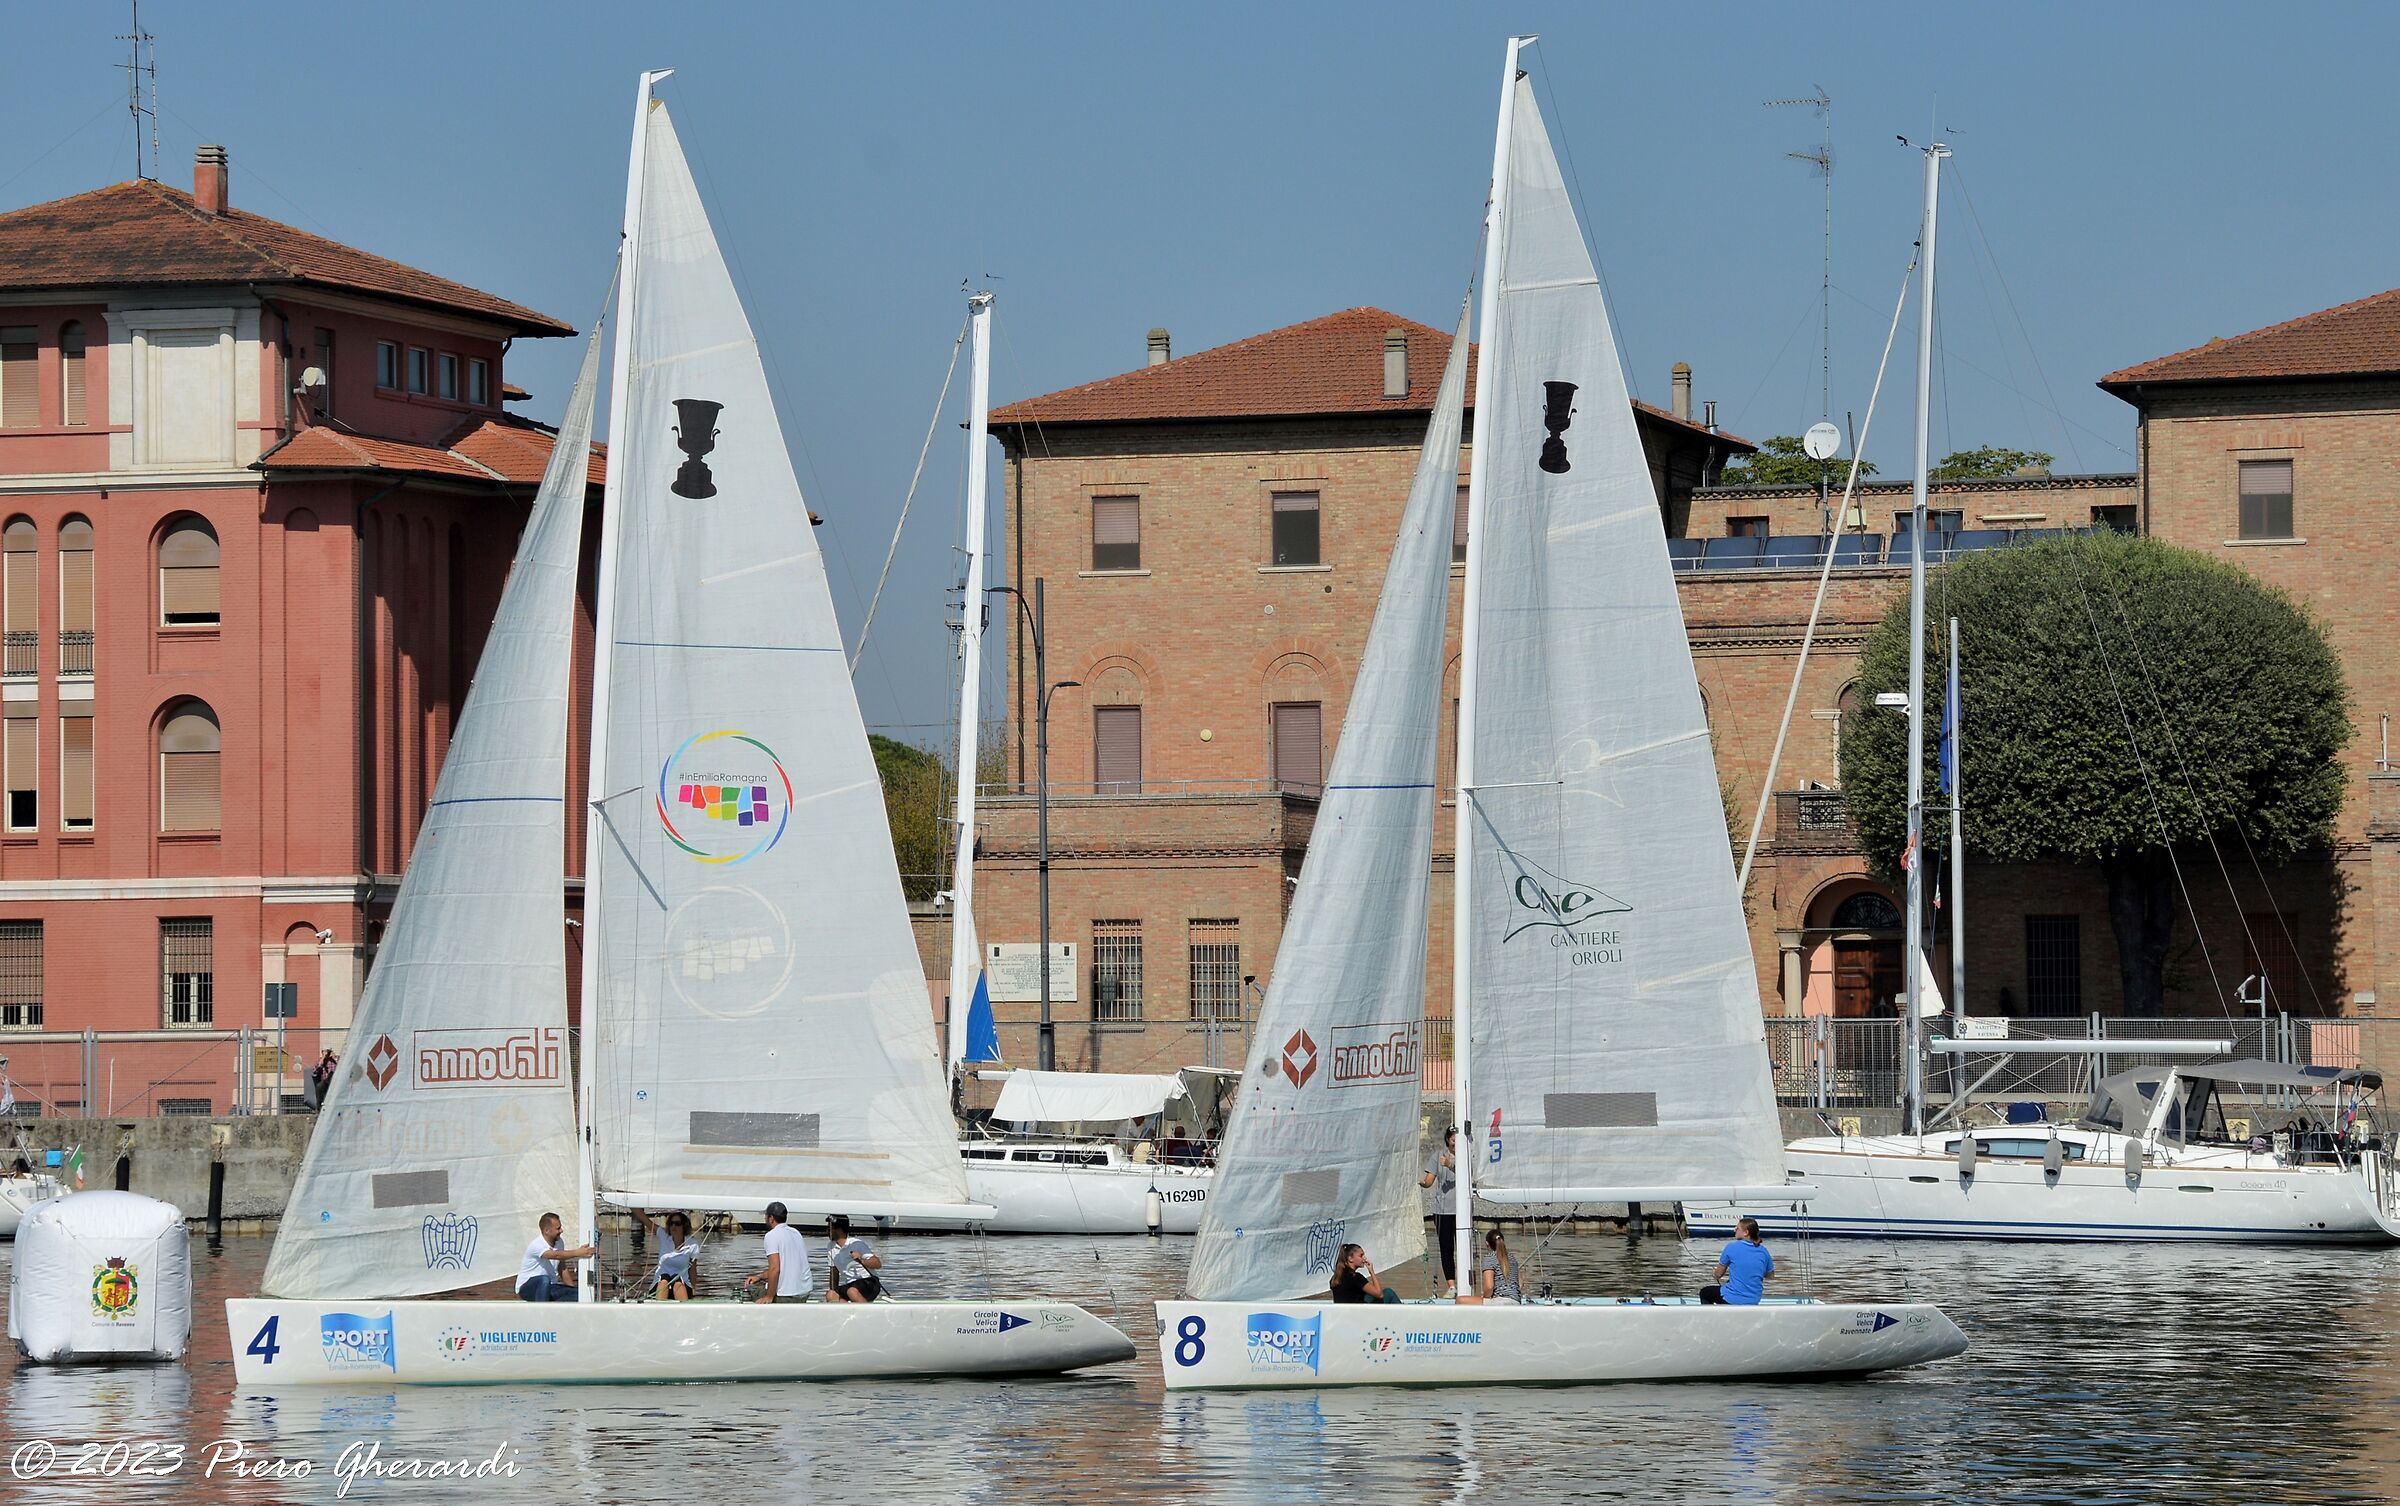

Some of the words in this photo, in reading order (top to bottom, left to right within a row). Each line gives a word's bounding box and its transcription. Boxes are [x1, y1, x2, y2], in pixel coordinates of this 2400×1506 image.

[679, 771, 768, 783] #inEmiliaRomagna
[1550, 931, 1621, 948] CANTIERE
[1572, 949, 1622, 966] ORIOLI
[1489, 1139, 1503, 1163] 3
[321, 1329, 389, 1347] SPORT
[479, 1332, 558, 1343] VIGLIENZONE
[956, 1327, 997, 1335] Ravennate
[1247, 1330, 1316, 1347] SPORT
[1405, 1332, 1483, 1344] VIGLIENZONE
[246, 1315, 281, 1365] 4
[1174, 1315, 1207, 1367] 8
[322, 1347, 391, 1362] VALLEY
[1248, 1347, 1315, 1364] VALLEY
